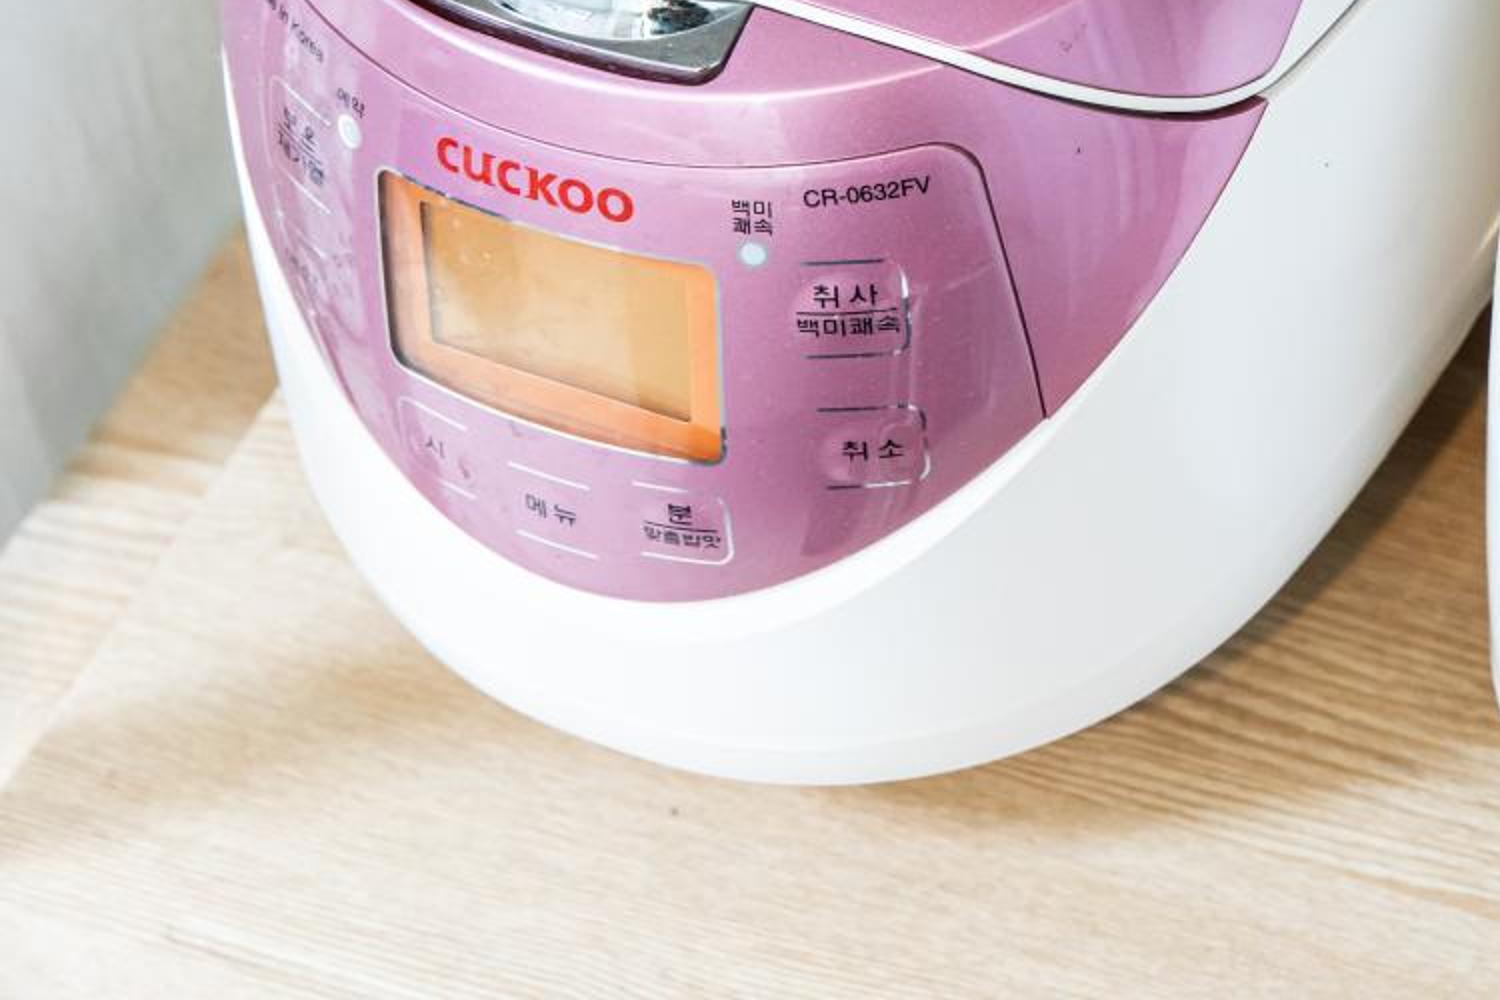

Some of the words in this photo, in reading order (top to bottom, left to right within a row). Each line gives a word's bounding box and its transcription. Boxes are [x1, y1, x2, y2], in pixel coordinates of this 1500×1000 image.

[436, 136, 635, 223] CUCKOO
[803, 175, 930, 209] CR-0632FV
[731, 199, 773, 219] 백미
[732, 218, 773, 236] 쾌속
[796, 313, 901, 337] 백미쾌속
